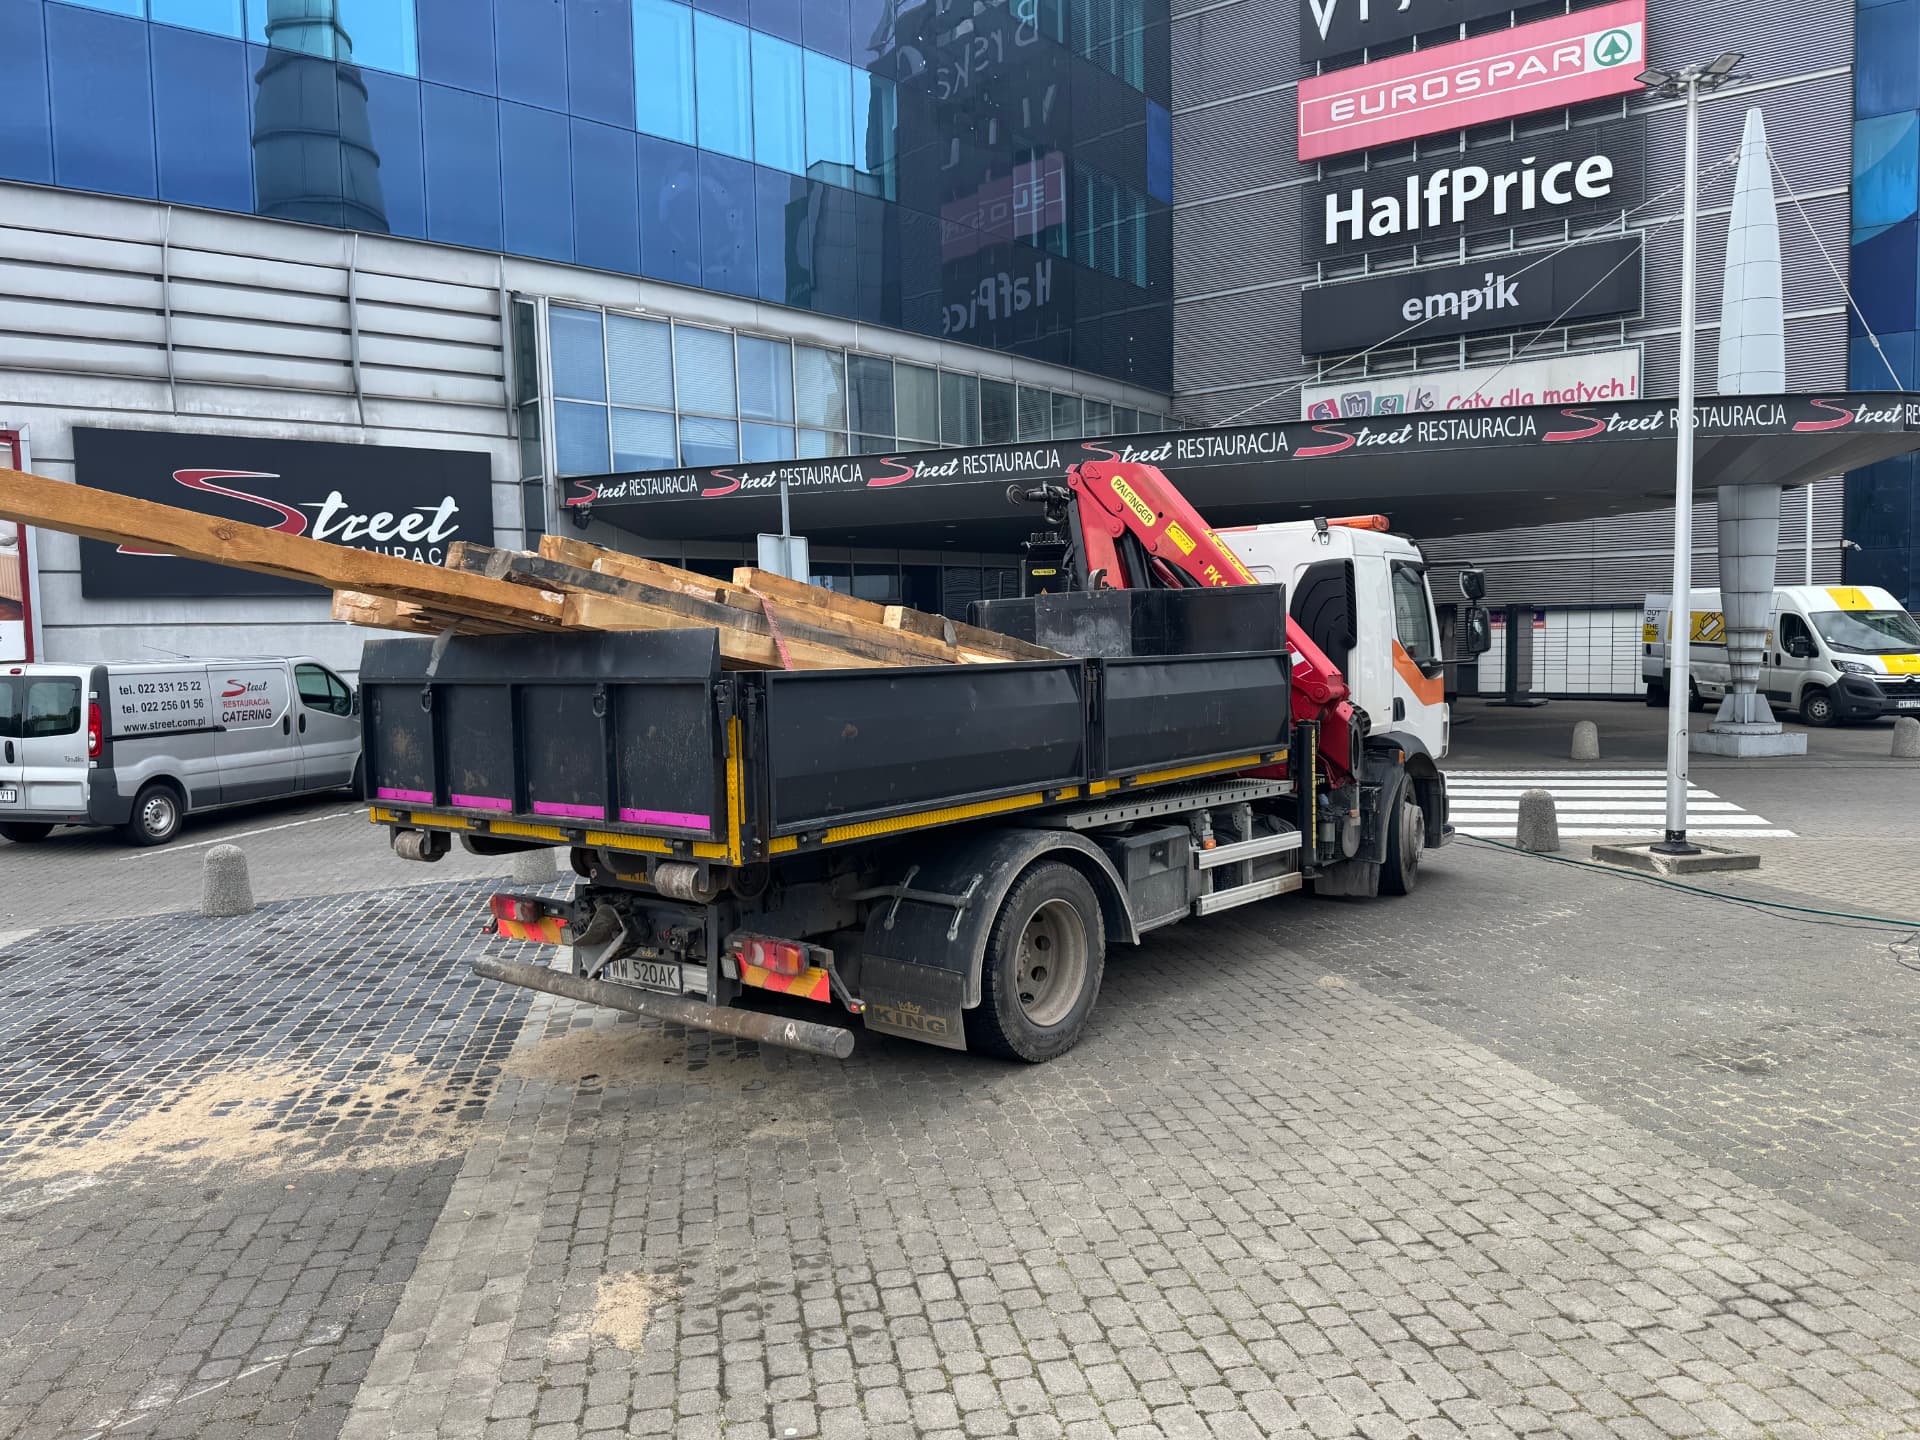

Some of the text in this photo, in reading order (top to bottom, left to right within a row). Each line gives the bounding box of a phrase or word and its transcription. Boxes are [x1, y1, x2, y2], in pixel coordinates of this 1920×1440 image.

[1331, 45, 1582, 122] EUROSPAR
[1325, 155, 1613, 245] HalfPrice
[1402, 272, 1519, 321] empik
[1500, 388, 1534, 407] dla
[566, 480, 627, 506] Street
[629, 475, 698, 496] RESTAURACJA
[701, 469, 777, 497] Street
[866, 457, 959, 487] Street
[963, 449, 1061, 475] RESTAURACJA
[1177, 432, 1289, 460] RESTAURACJA
[1293, 423, 1413, 457] Street
[1418, 415, 1537, 443] RESTAURACJA
[1542, 408, 1664, 442] Street
[1670, 404, 1787, 429] RSTAURACJA
[1792, 399, 1903, 432] Street
[1113, 478, 1153, 524] PALFINGER
[119, 681, 201, 695] tel. 022 331 25 22
[122, 699, 204, 714] tel. 022 256 01 56
[222, 708, 272, 722] CATERING
[124, 716, 206, 733] www.street.com.pl
[633, 961, 676, 987] 520AK
[873, 1007, 946, 1033] KING
